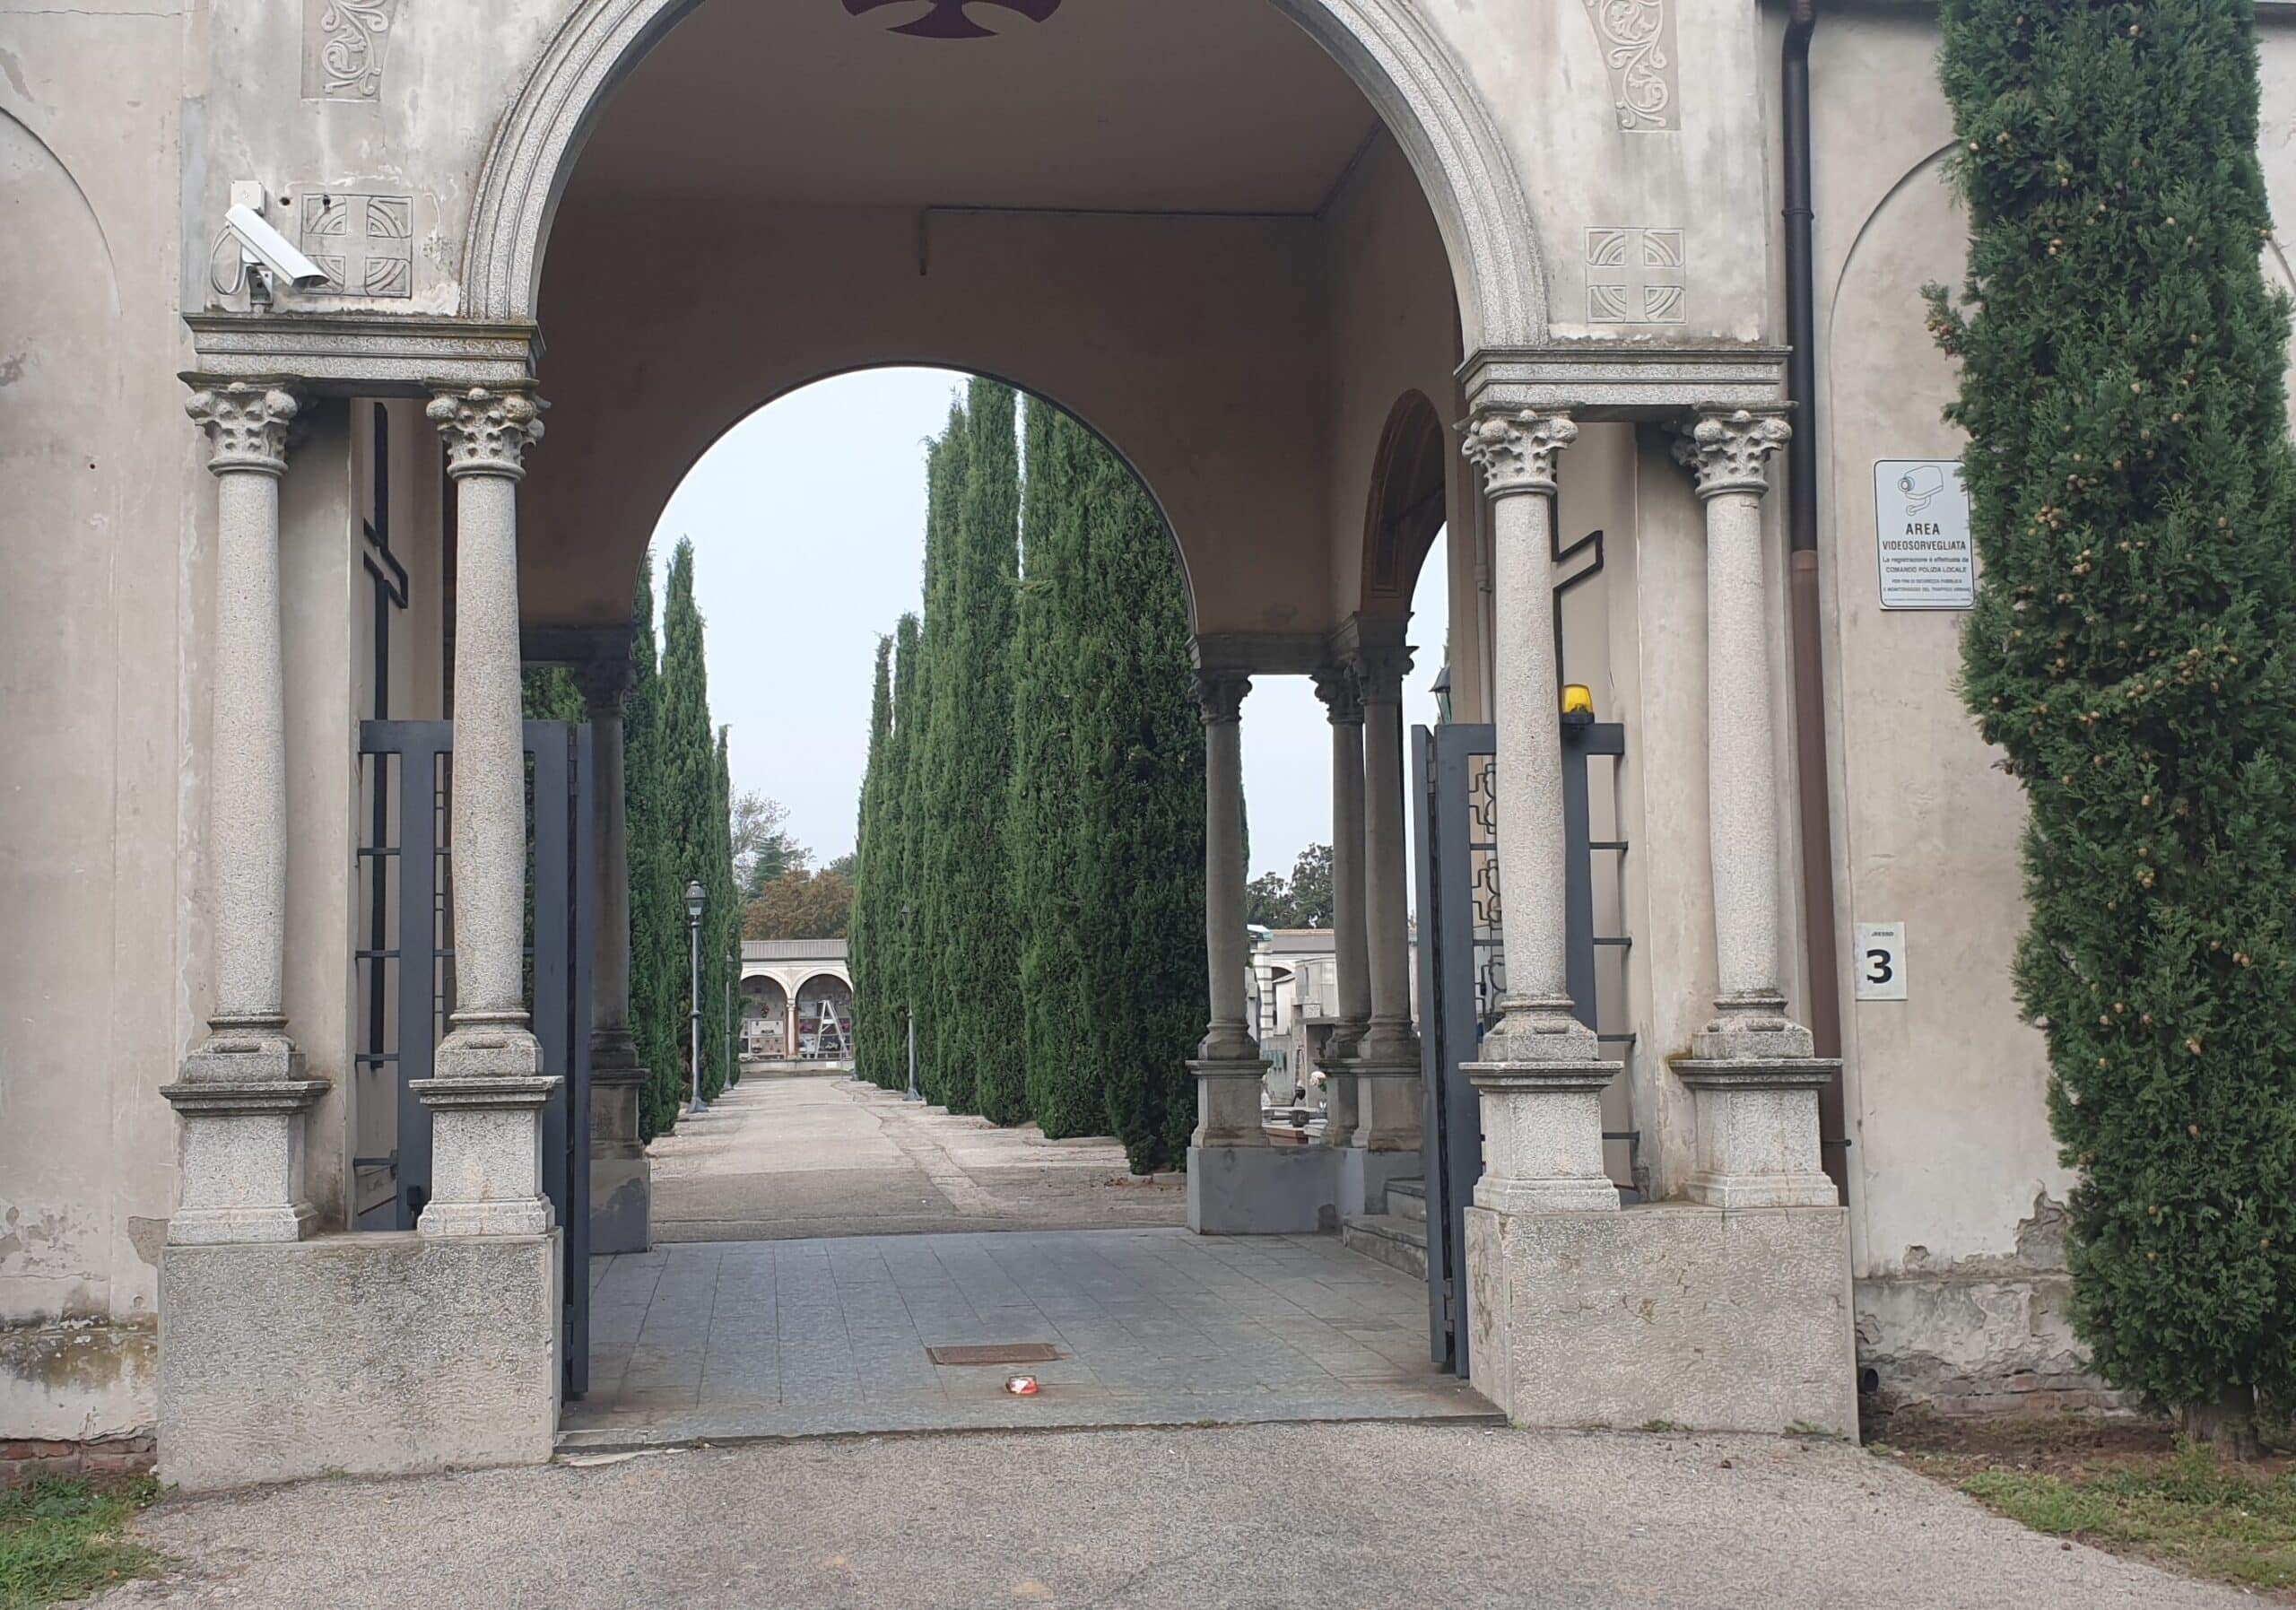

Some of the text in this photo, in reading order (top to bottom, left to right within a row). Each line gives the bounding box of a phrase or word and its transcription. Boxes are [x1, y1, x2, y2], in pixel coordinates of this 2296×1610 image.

[1906, 523, 1940, 535] AREA
[1883, 541, 1966, 550] VIDEOSORVEGLIATA
[1866, 949, 1892, 984] 3
